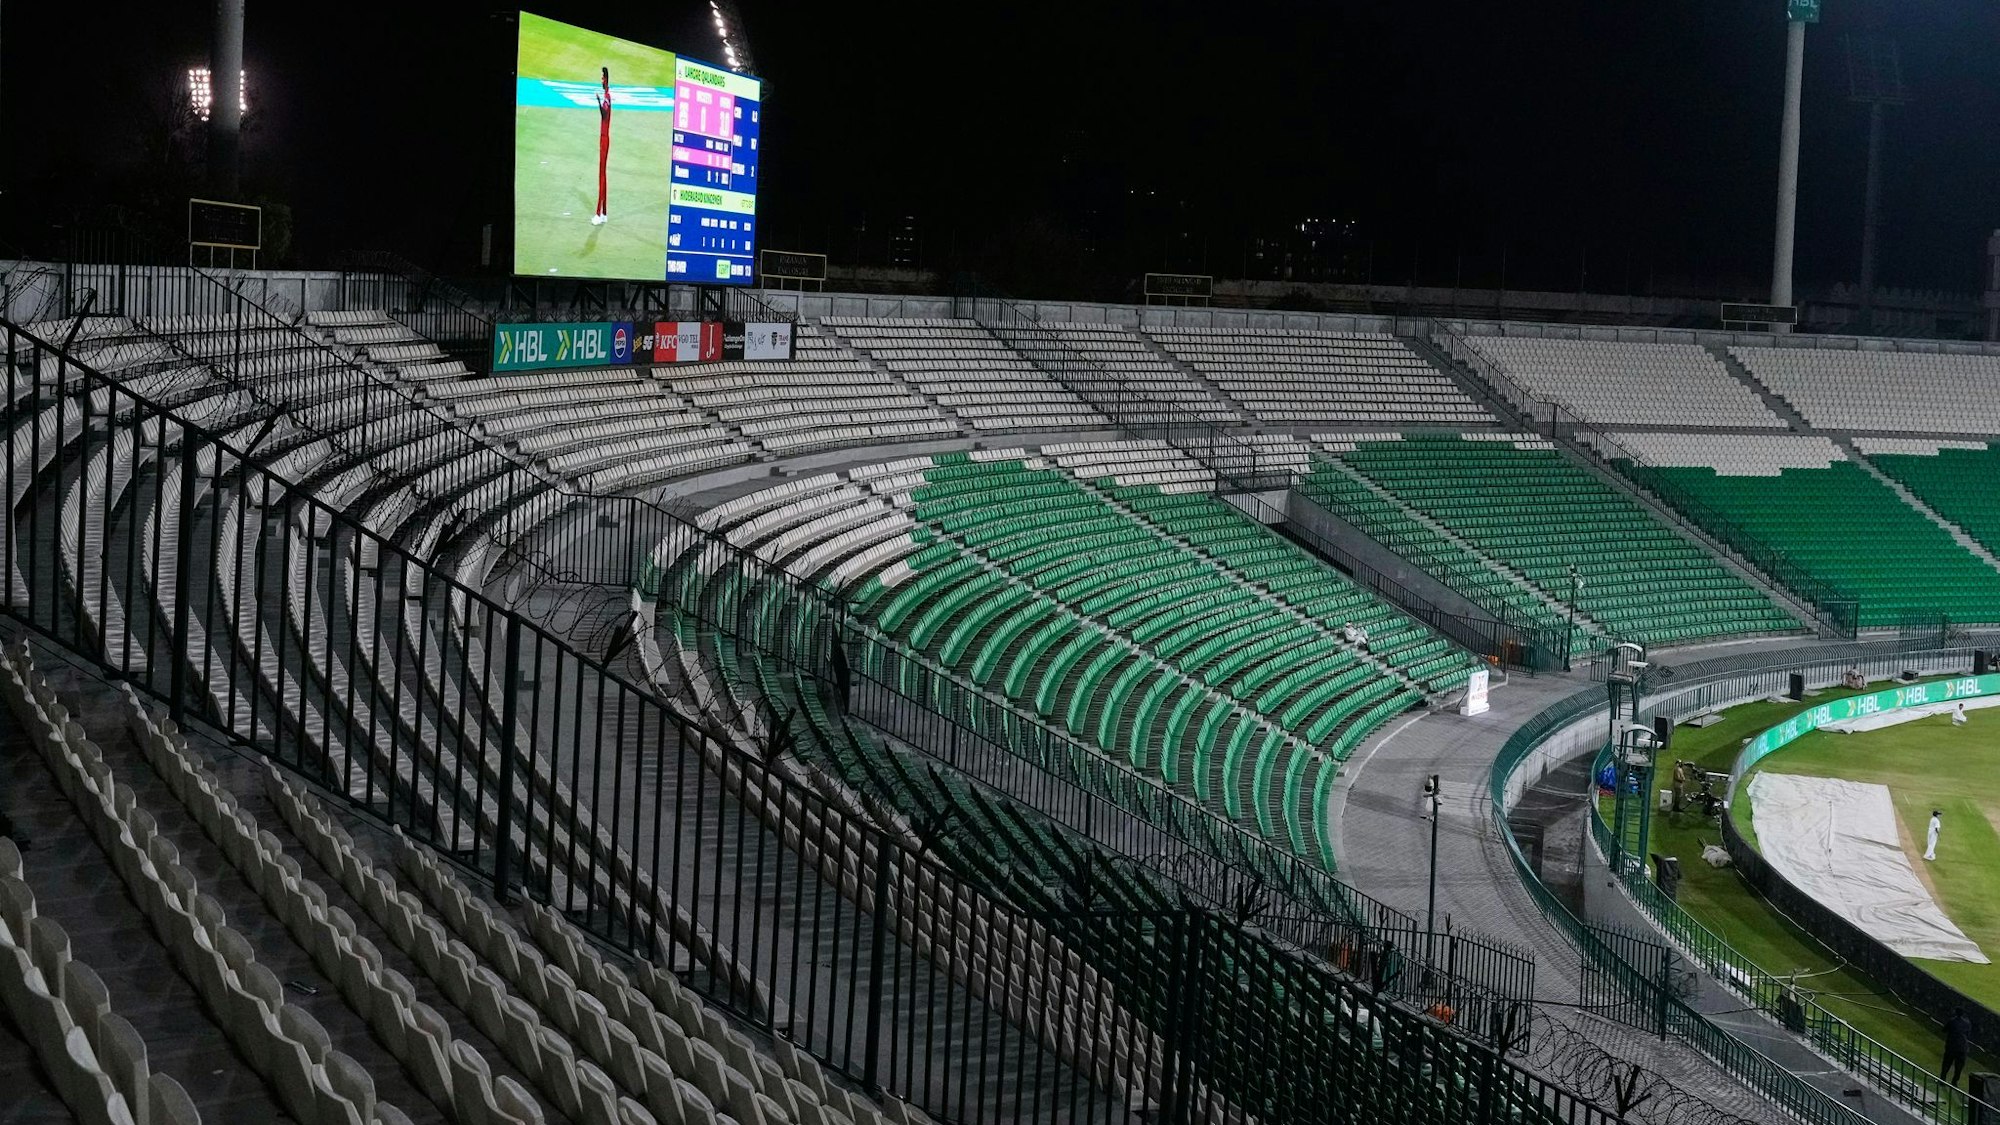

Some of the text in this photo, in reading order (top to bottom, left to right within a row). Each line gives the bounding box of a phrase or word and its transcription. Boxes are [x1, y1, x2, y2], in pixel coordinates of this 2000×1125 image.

[685, 65, 701, 81] LAHORE
[514, 330, 548, 363] HBL
[572, 329, 607, 360] HBL
[643, 336, 654, 350] 5G
[660, 334, 677, 350] KFC
[689, 334, 699, 344] TEL
[1906, 686, 1929, 705] HBL
[1956, 678, 1982, 696] HBL
[1857, 694, 1881, 715] HBL
[1813, 705, 1833, 726] HBL
[1786, 719, 1799, 740] HBL
